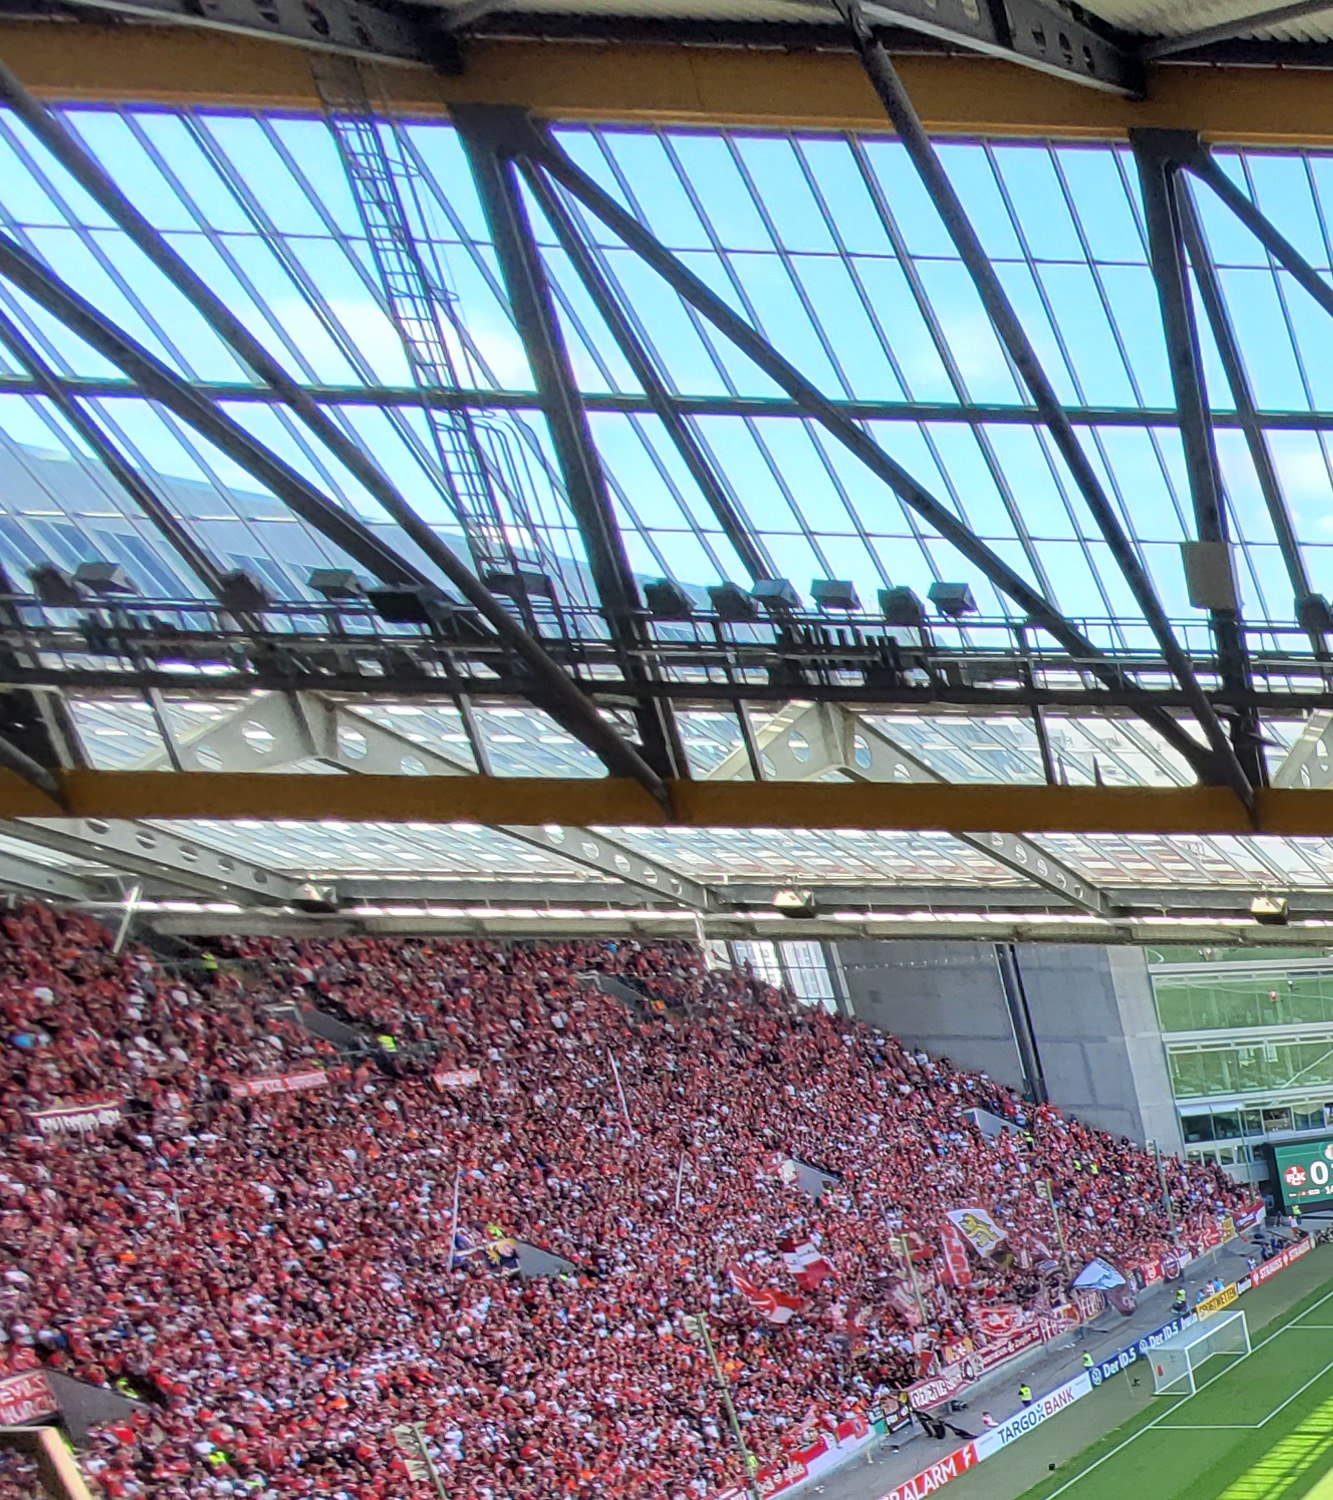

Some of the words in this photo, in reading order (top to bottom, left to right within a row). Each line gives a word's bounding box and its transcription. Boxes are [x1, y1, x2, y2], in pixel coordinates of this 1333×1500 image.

[1149, 1333, 1164, 1349] Der
[1162, 1321, 1179, 1342] ID.5
[1102, 1359, 1119, 1378] Der
[1118, 1347, 1137, 1368] ID.5
